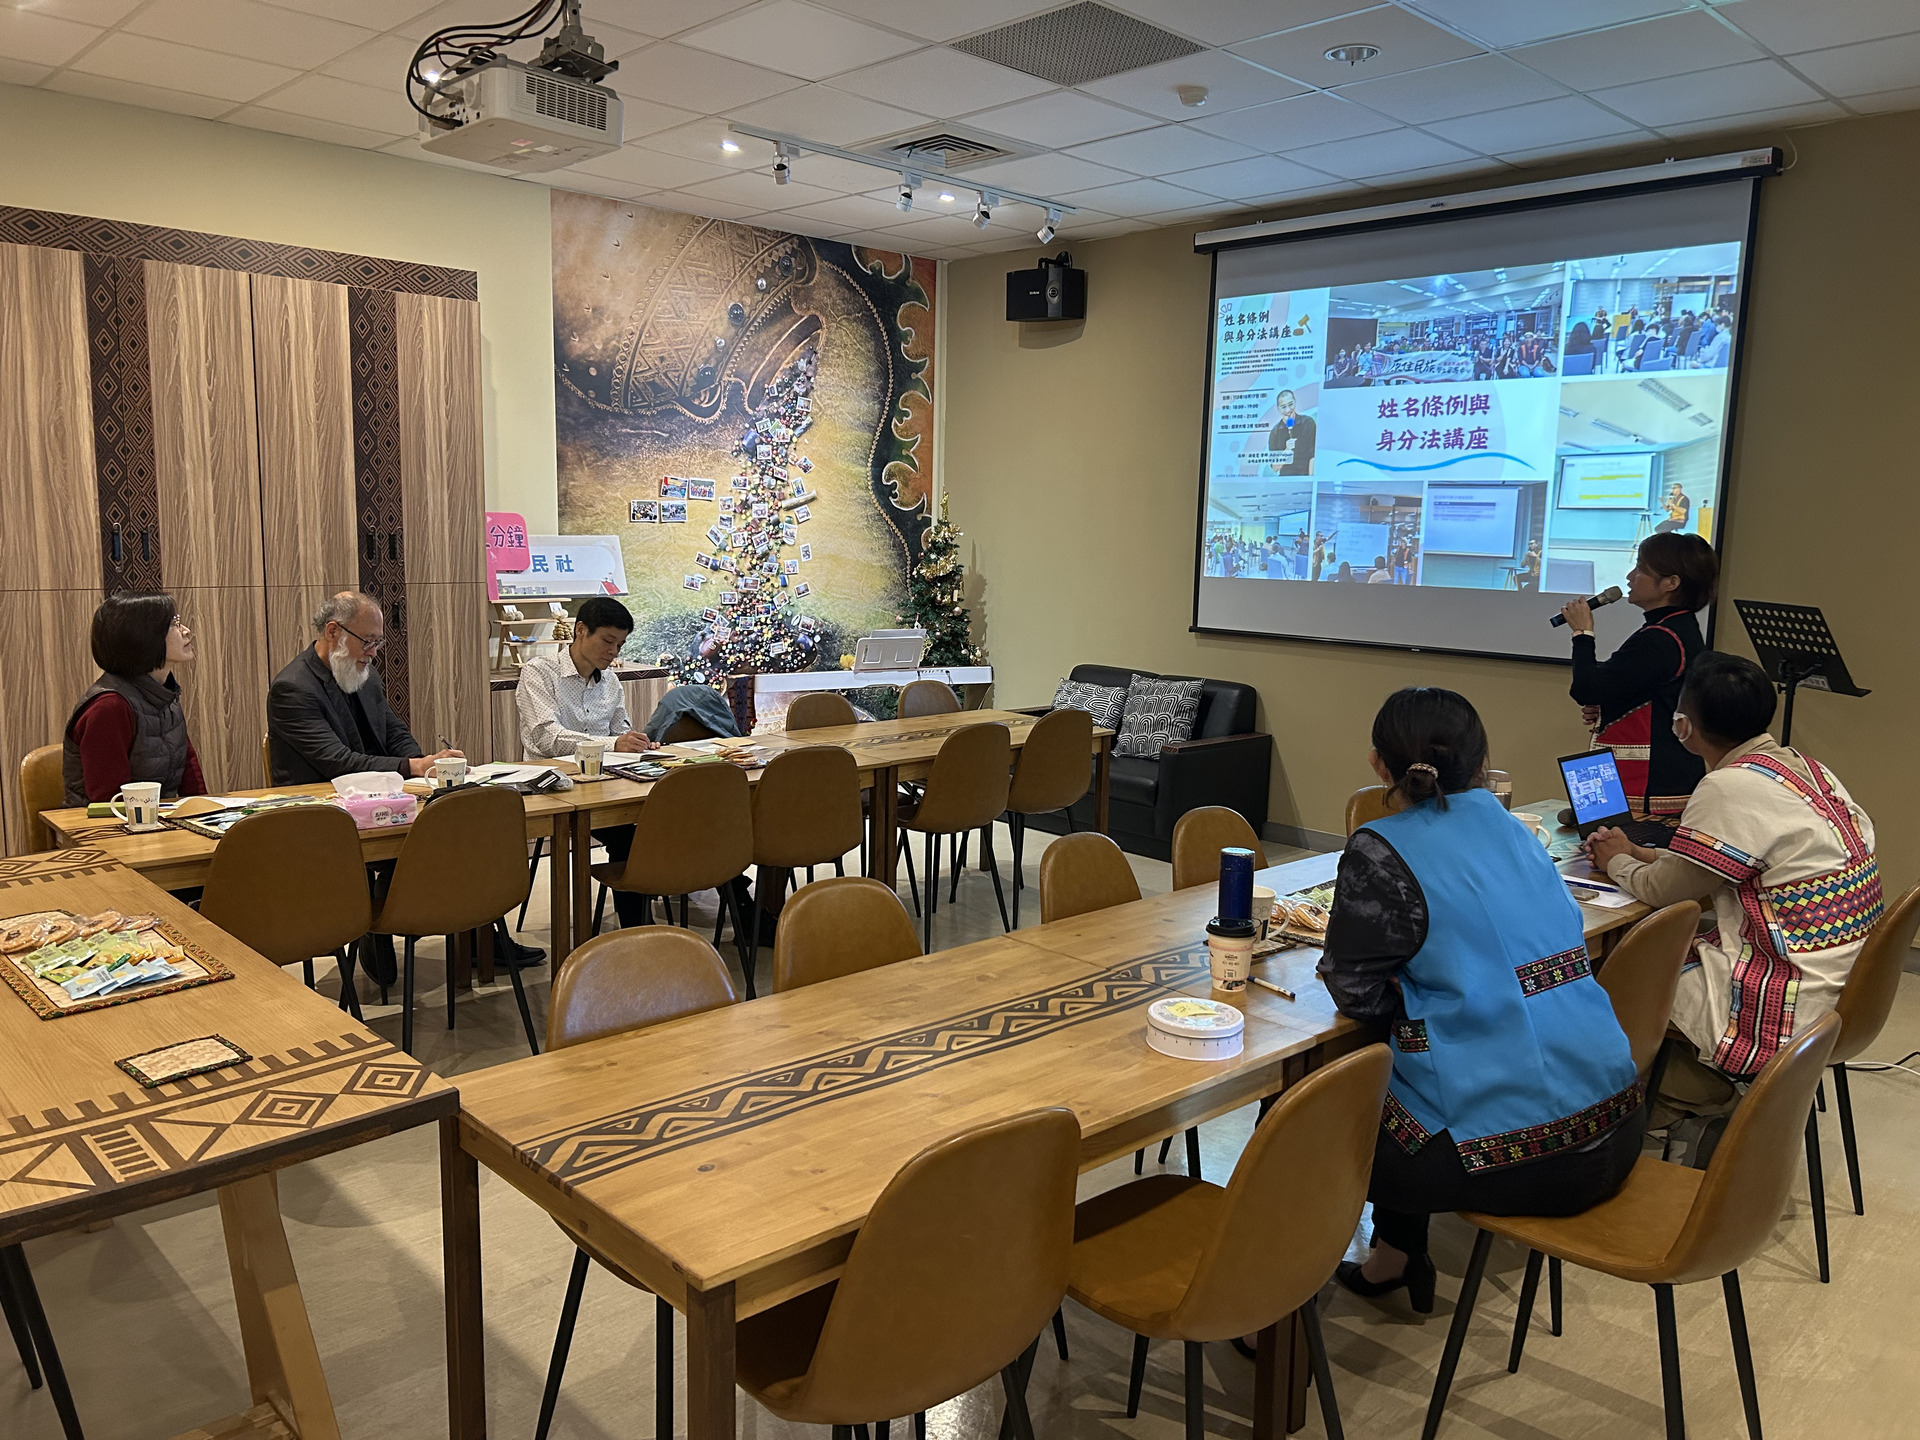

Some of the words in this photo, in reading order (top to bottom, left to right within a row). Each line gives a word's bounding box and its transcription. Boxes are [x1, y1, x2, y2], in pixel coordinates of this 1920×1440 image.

[1224, 310, 1270, 327] 姓名條例
[1223, 325, 1292, 344] 與身分法講座
[1390, 358, 1437, 374] 原住民族
[1377, 394, 1490, 419] 姓名條例與
[1375, 426, 1489, 451] 身分法講座
[485, 525, 526, 548] 分鐘
